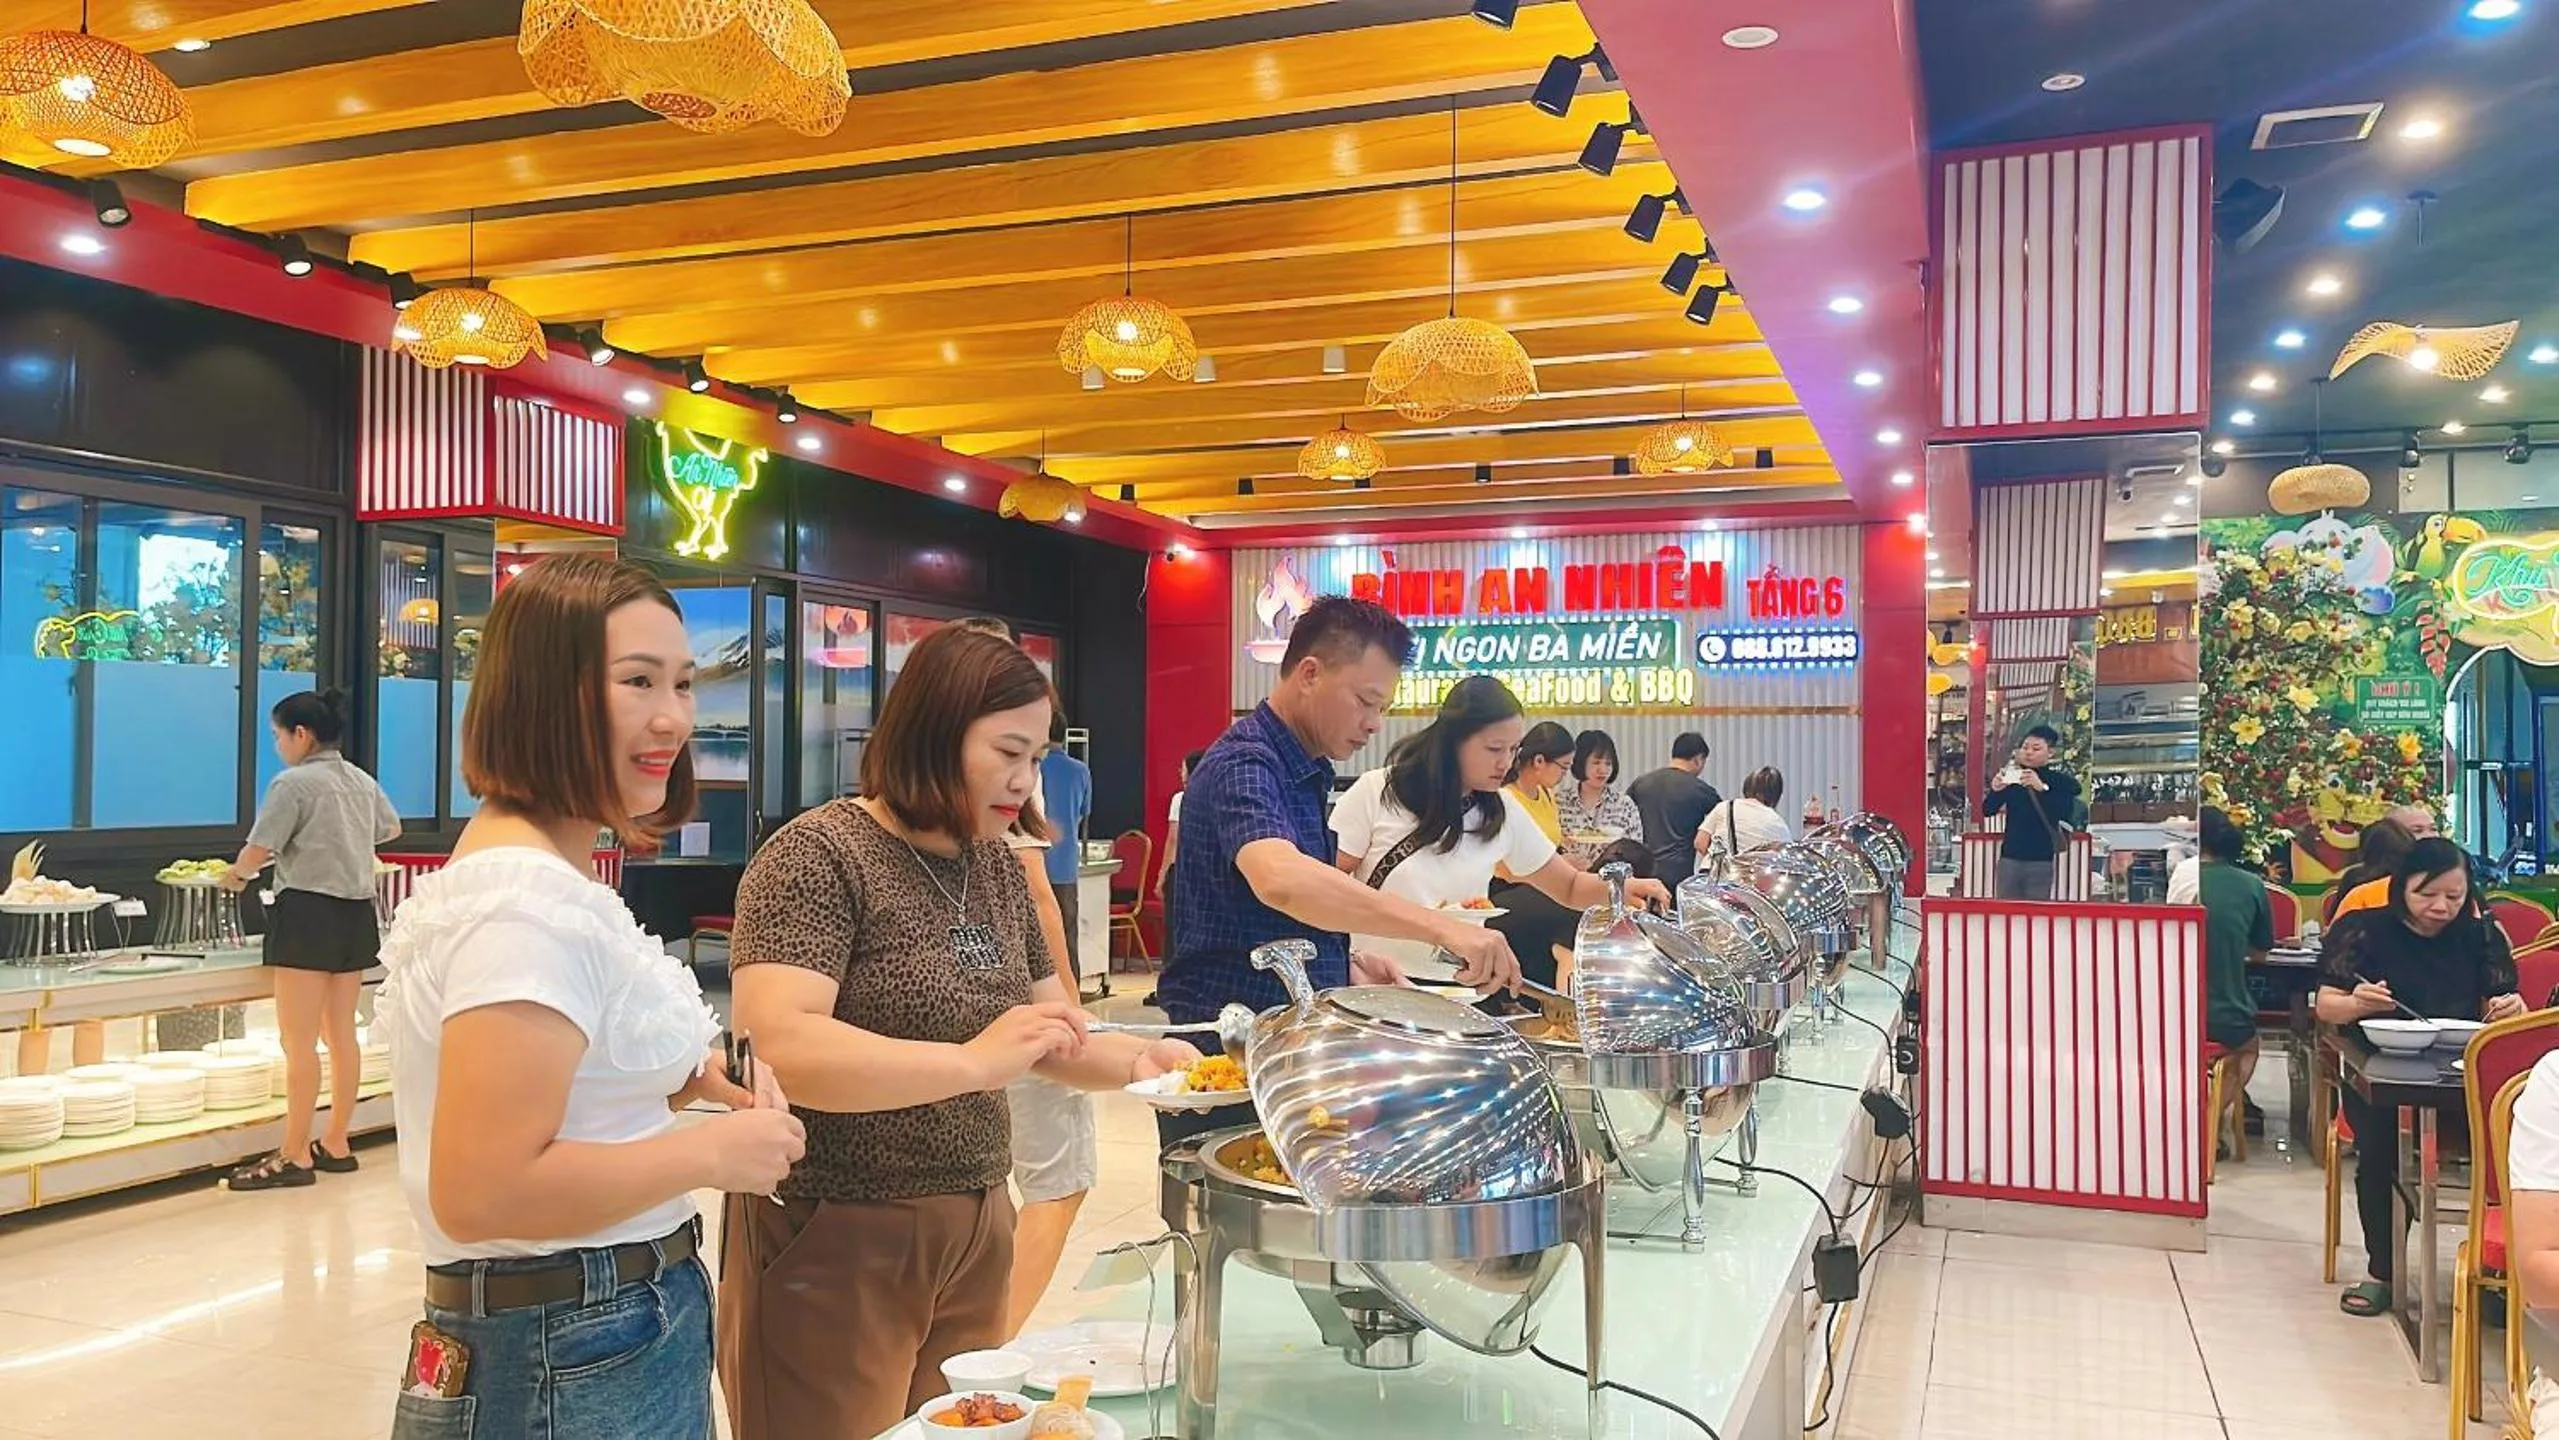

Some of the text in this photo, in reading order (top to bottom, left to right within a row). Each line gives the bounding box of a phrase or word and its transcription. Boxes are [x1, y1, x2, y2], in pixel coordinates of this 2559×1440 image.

[1479, 567, 1549, 615] AN
[1564, 545, 1724, 612] NHIÊN
[1824, 576, 1844, 617] 6
[1433, 633, 1521, 667] NGON
[1610, 668, 1631, 703] &
[1639, 668, 1694, 706] BBQ
